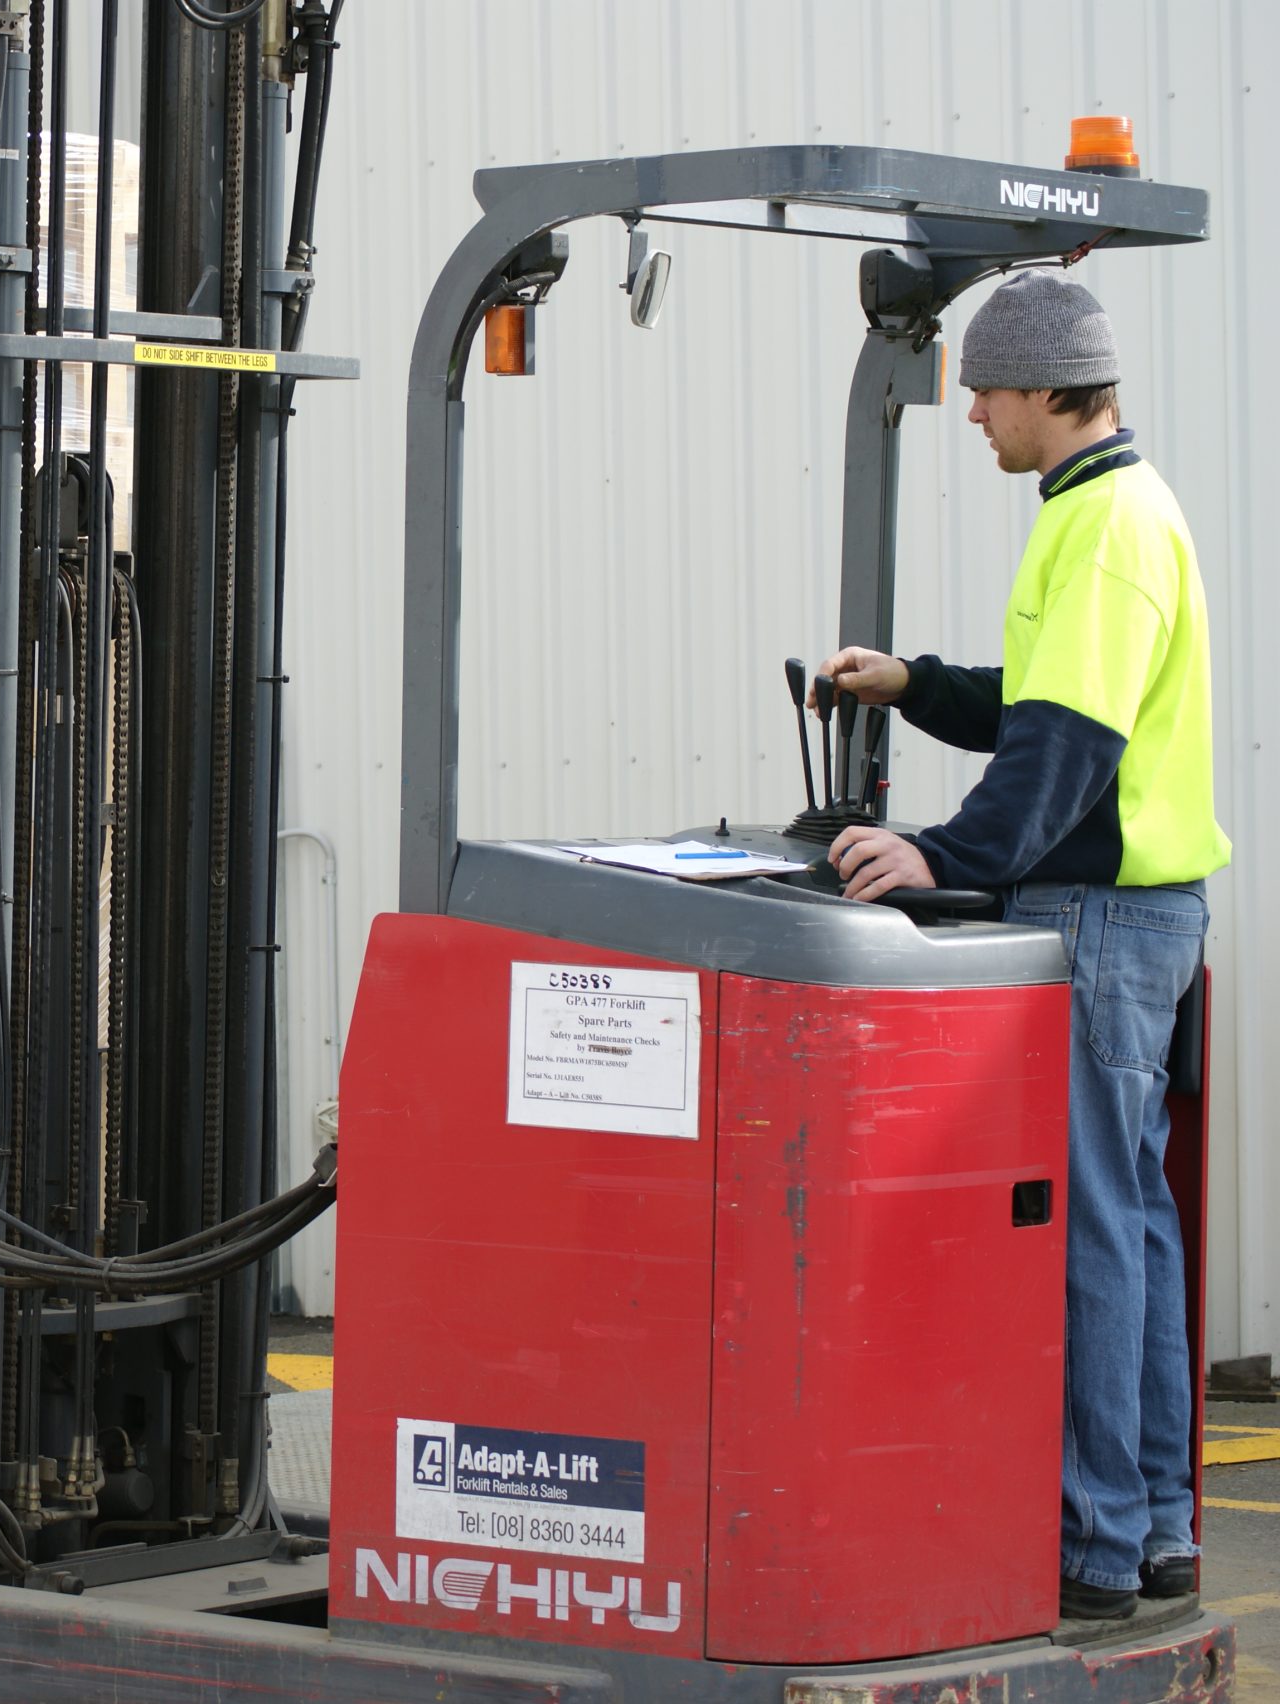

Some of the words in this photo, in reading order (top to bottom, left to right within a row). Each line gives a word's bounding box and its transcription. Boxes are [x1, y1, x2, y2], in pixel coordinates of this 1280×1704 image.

[1000, 179, 1099, 217] NICHIYU
[142, 347, 151, 359] DO
[154, 349, 166, 360] NOT
[169, 350, 183, 361] SIDE
[186, 352, 204, 362] SHIFT
[206, 353, 236, 365] BETWEEN
[238, 354, 250, 366] THE
[252, 355, 268, 367] LEGS
[566, 996, 588, 1006] GPA
[591, 998, 607, 1008] 477
[610, 998, 646, 1010] Forklift
[578, 1015, 604, 1027] Spare
[608, 1017, 632, 1028] Parts
[550, 1031, 571, 1040] Safety
[588, 1033, 632, 1044] Maintenance
[634, 1037, 660, 1046] Checks
[458, 1443, 599, 1483] Adapt-A-Lift
[457, 1476, 491, 1492] Forklift
[493, 1480, 529, 1496] Rentals
[530, 1483, 538, 1497] &
[540, 1484, 568, 1500] Sales
[458, 1510, 485, 1535] Tel:
[491, 1512, 524, 1541] [08]
[530, 1520, 574, 1544] 8360
[580, 1524, 625, 1549] 3444
[356, 1547, 681, 1633] NICHIYU
